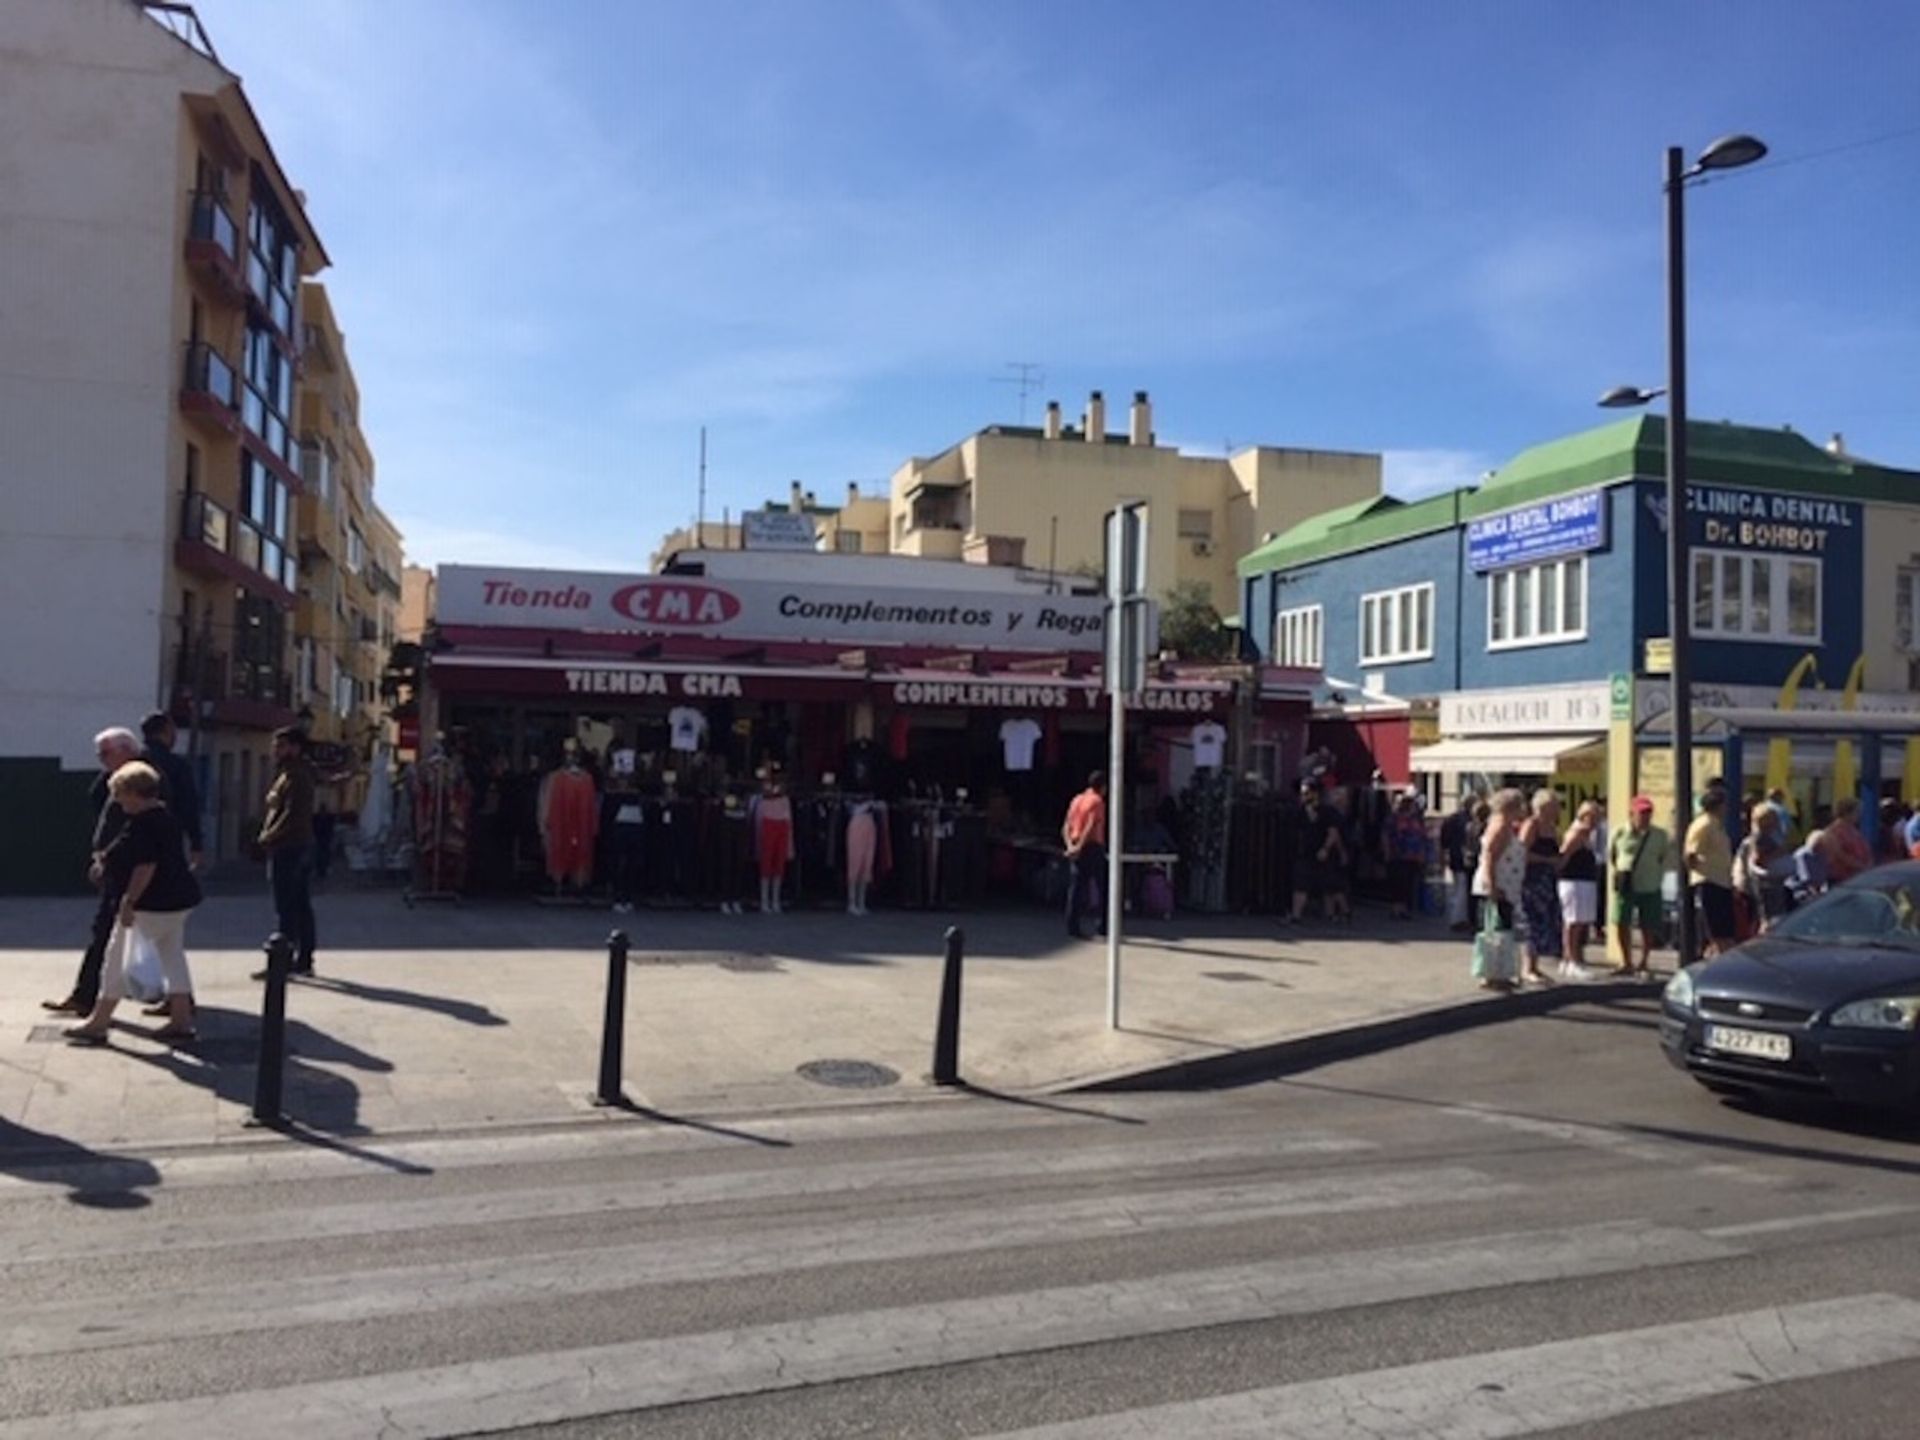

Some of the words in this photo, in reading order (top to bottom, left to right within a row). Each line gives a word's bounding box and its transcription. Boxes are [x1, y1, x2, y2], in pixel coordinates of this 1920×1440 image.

[1772, 497, 1852, 526] DENTAL
[1705, 519, 1736, 544] Dr.
[1739, 521, 1828, 551] BOHBOT
[482, 580, 592, 609] Tienda
[628, 586, 725, 621] CMA
[779, 595, 993, 625] Complementos
[1007, 611, 1024, 632] y
[565, 670, 668, 695] TIENDA
[682, 674, 742, 697] CMA
[893, 682, 1067, 707] COMPLEMENTOS
[1084, 688, 1099, 709] Y
[1119, 688, 1214, 712] REGALOS
